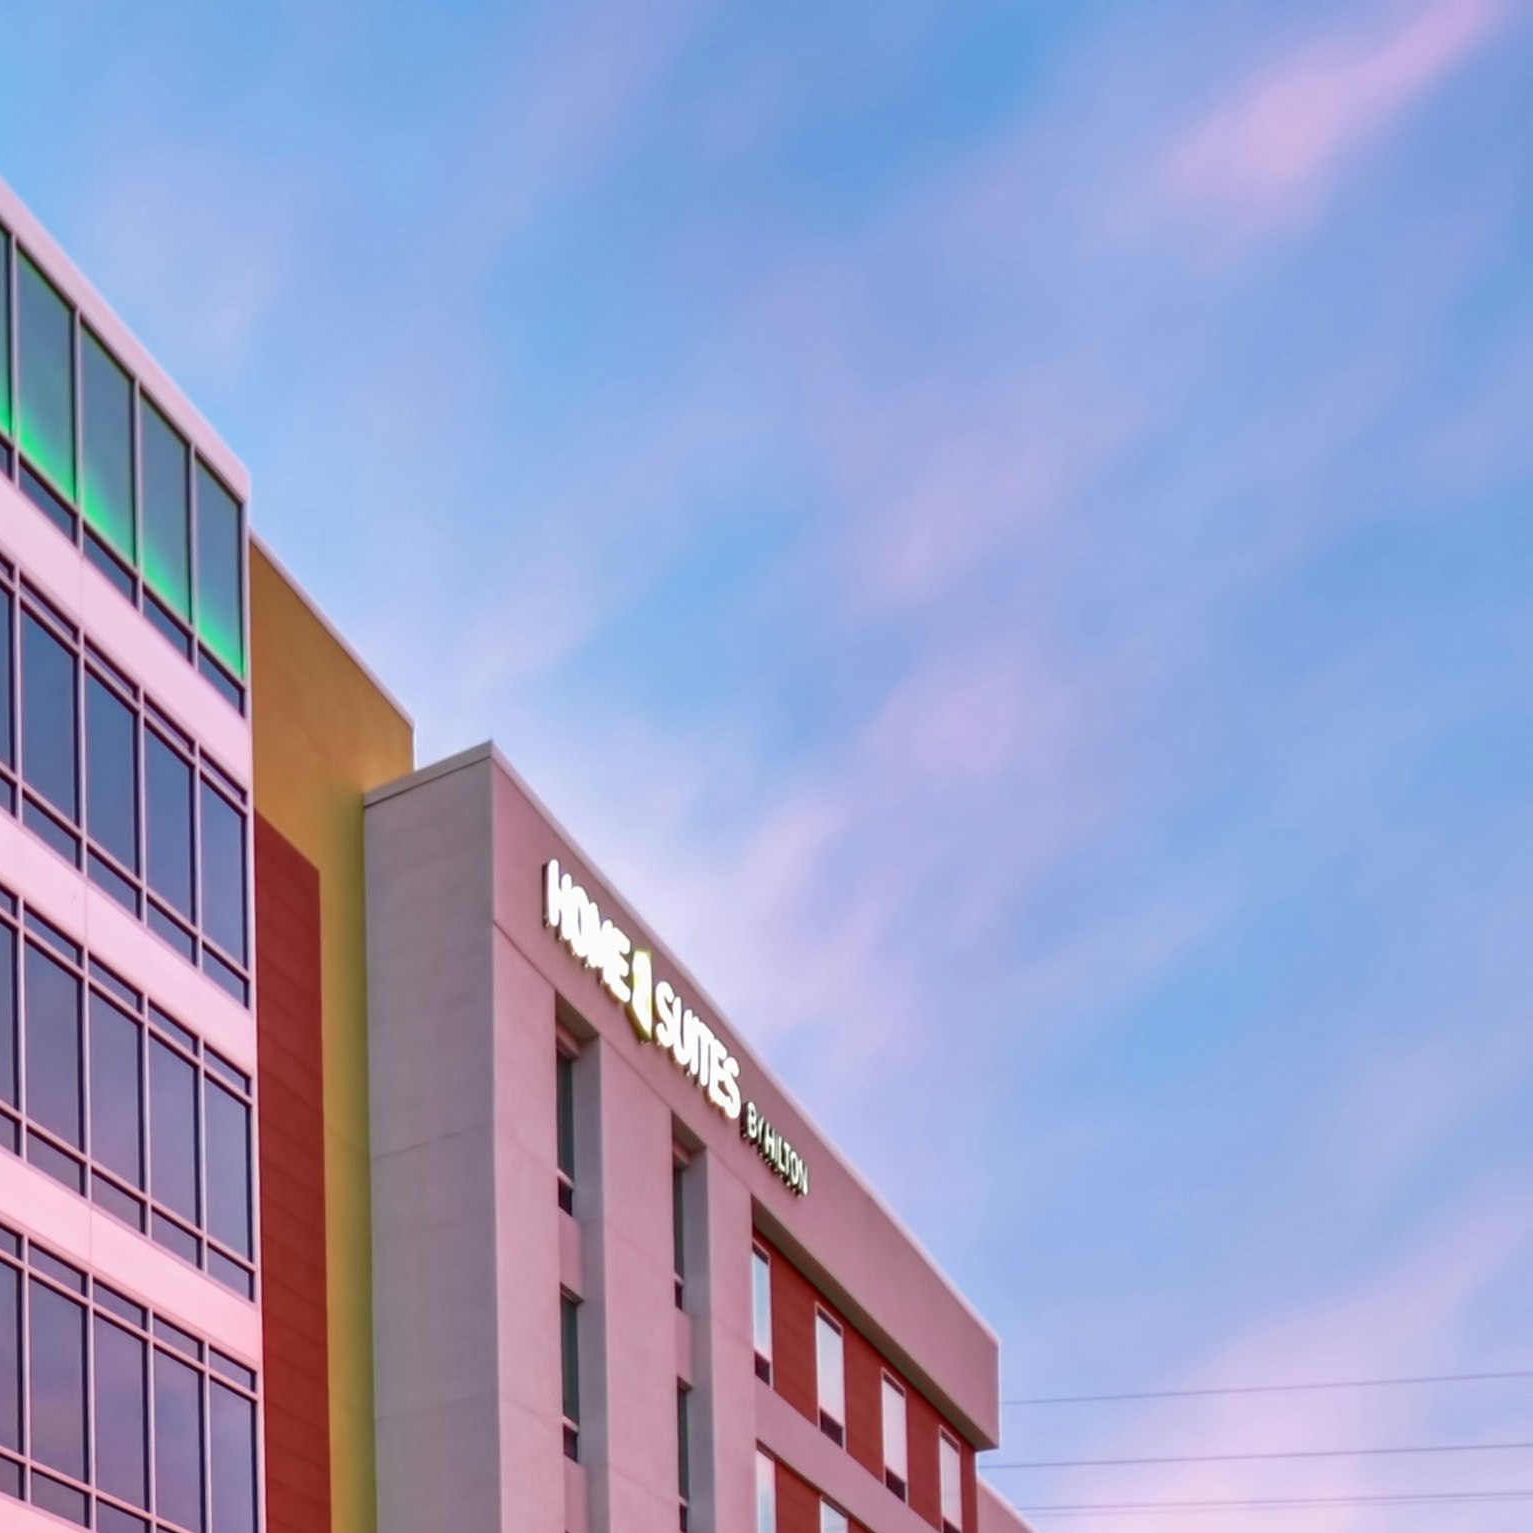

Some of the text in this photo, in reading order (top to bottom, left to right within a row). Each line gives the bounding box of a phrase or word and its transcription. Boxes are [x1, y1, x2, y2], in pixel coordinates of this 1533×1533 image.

[547, 858, 631, 1003] HOME
[655, 981, 741, 1119] SUITES
[747, 1101, 809, 1196] BY HILTON
